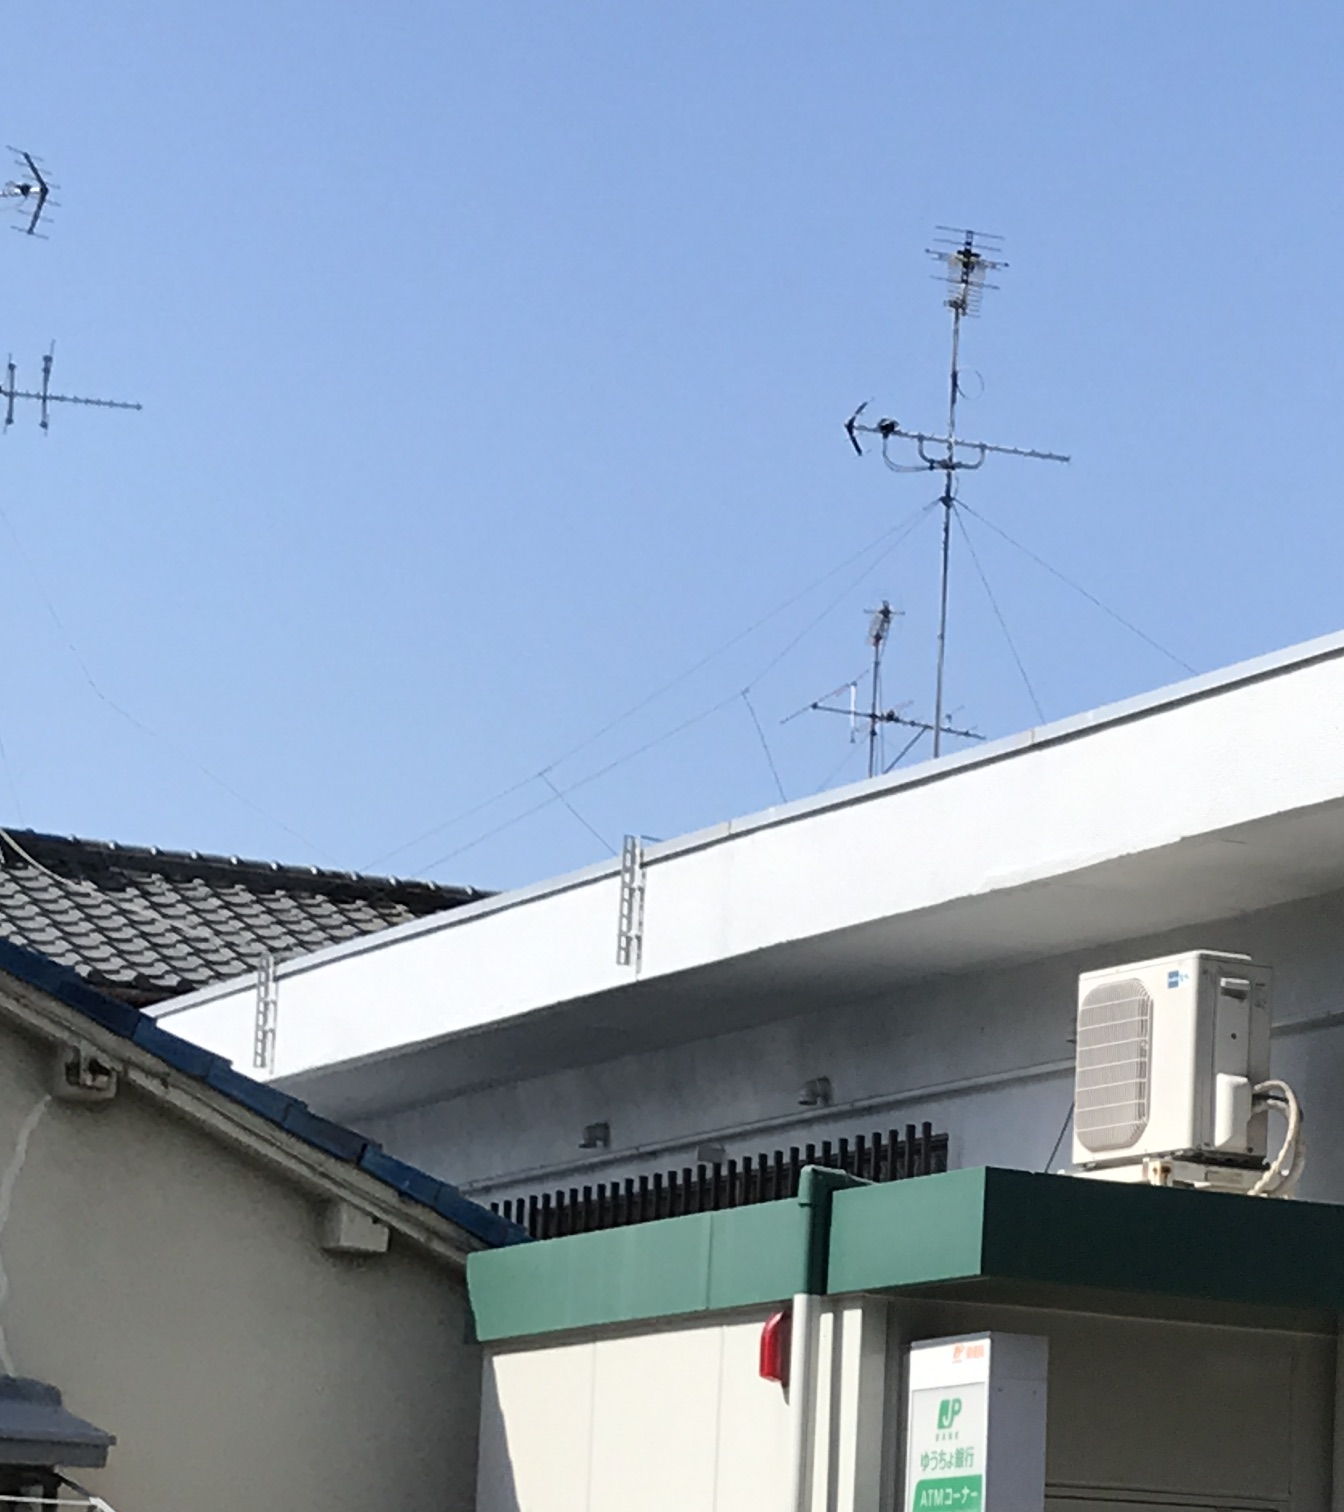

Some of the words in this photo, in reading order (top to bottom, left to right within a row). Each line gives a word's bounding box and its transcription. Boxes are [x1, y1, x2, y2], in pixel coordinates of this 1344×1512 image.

[920, 1446, 975, 1472] ゆうちょ銀行
[920, 1486, 979, 1508] ATMコーナー
